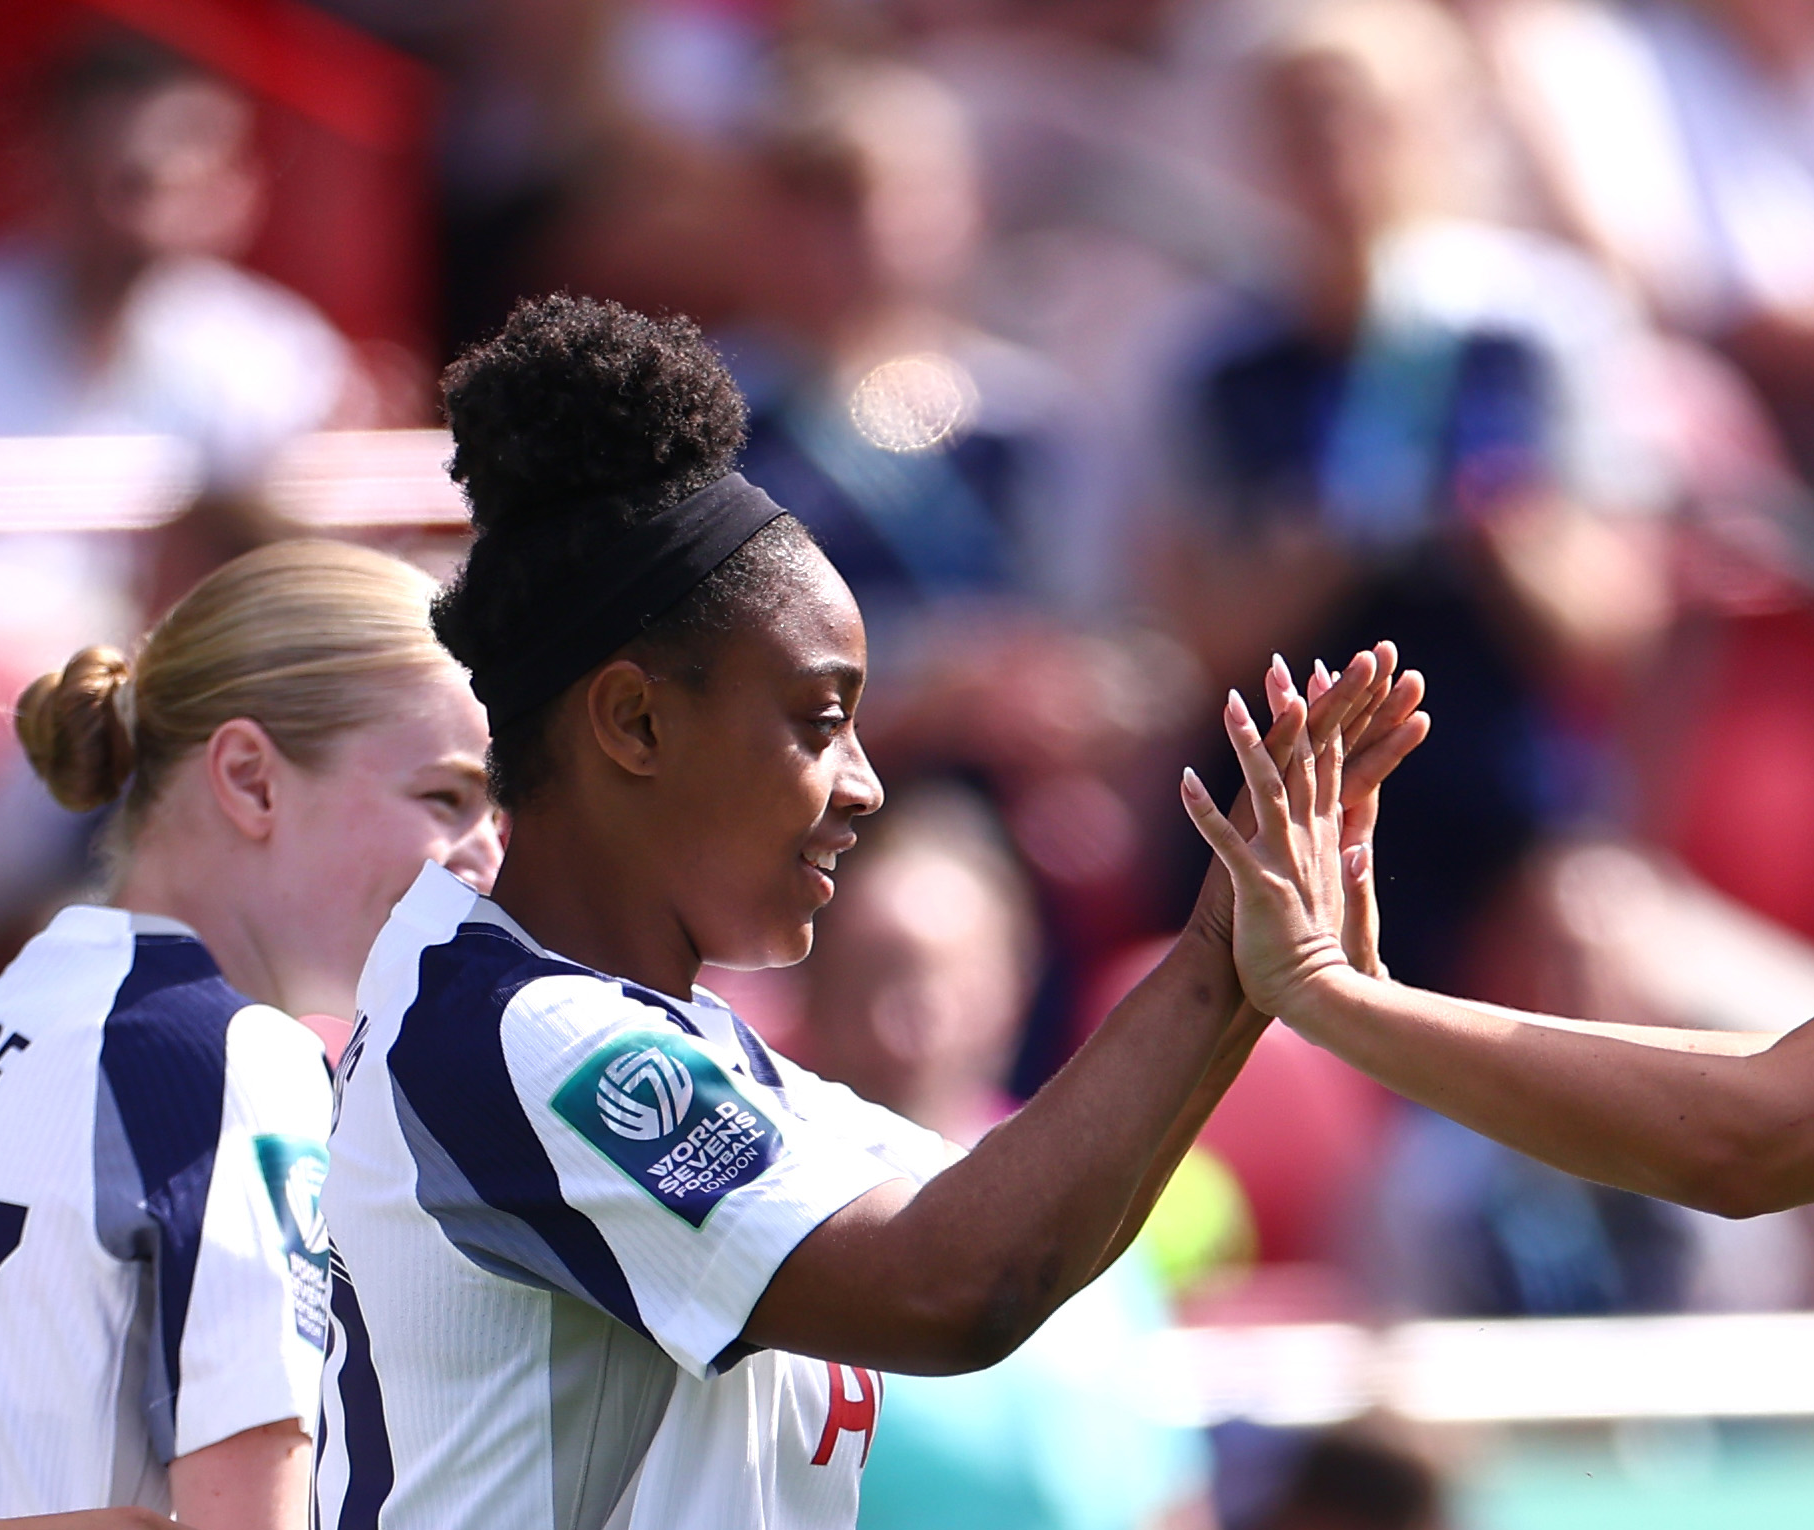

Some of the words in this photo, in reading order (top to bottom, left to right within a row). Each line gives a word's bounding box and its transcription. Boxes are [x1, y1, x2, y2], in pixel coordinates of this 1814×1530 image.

[646, 1101, 739, 1177] WORLD
[658, 1111, 757, 1194] SEVENS
[675, 1129, 766, 1198] FOOTBALL
[699, 1147, 759, 1193] LONDON
